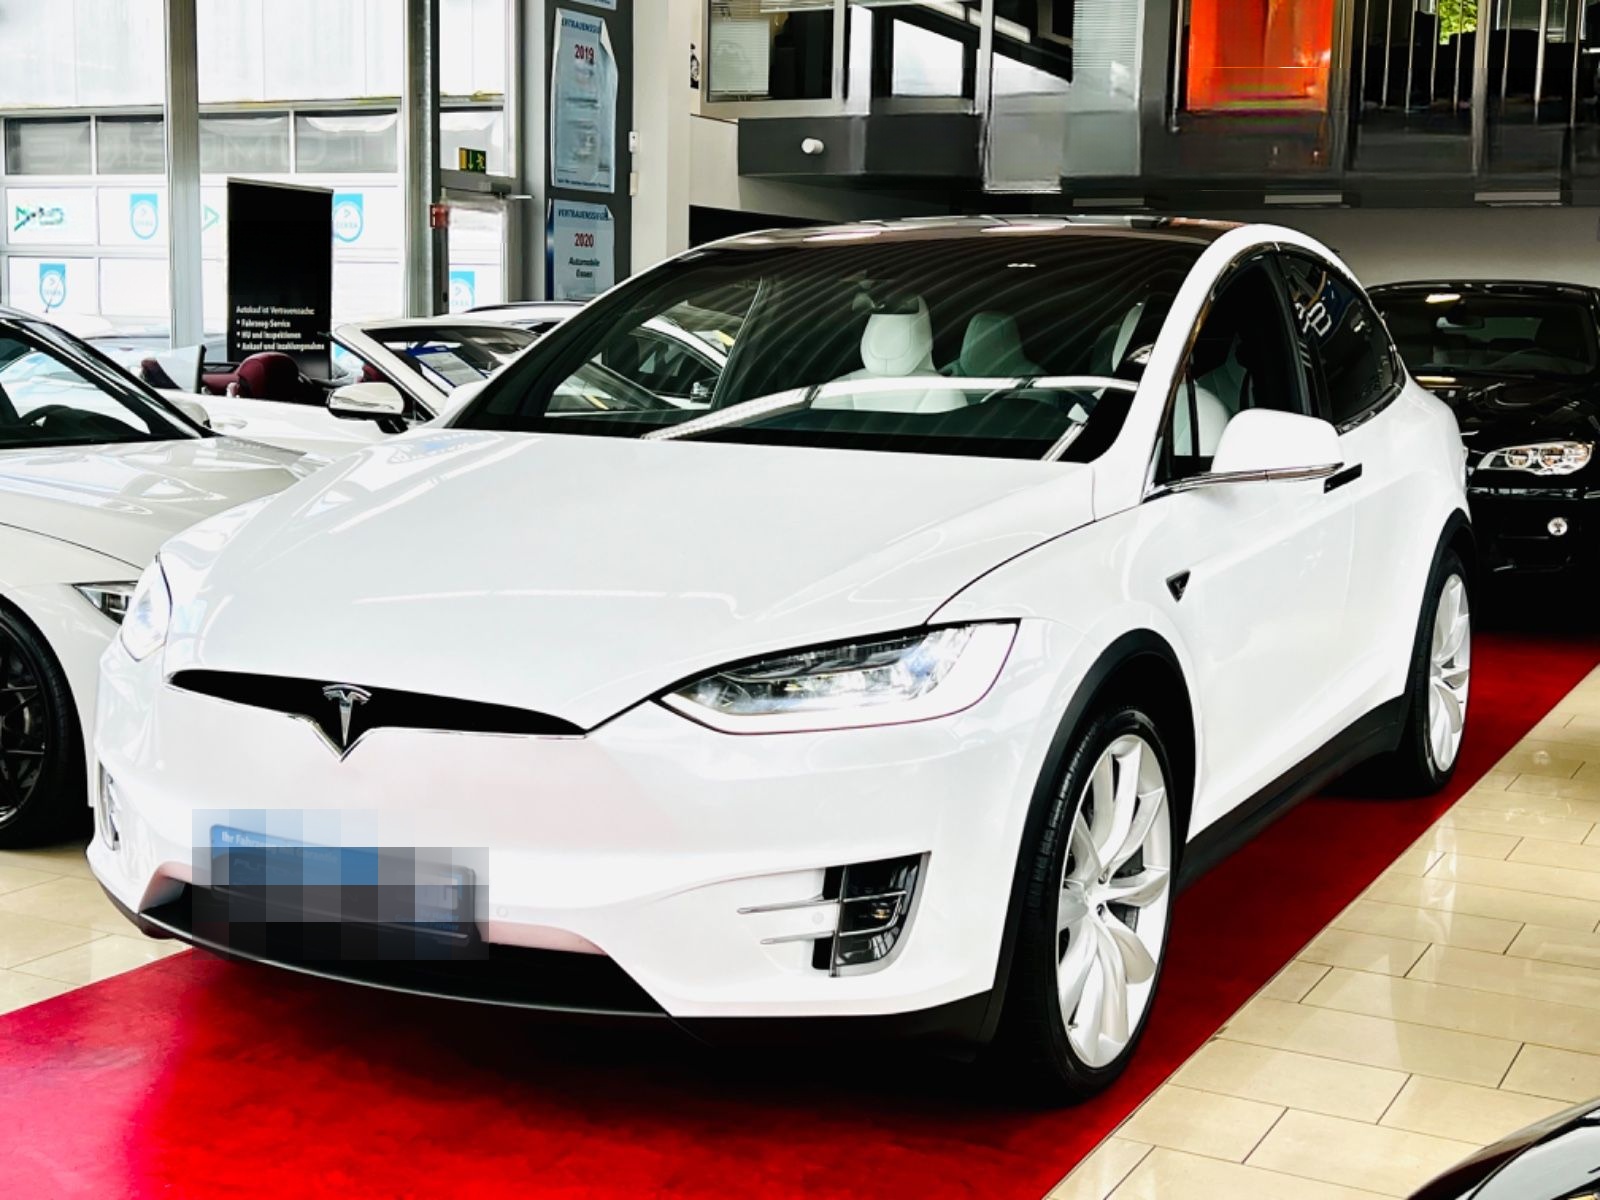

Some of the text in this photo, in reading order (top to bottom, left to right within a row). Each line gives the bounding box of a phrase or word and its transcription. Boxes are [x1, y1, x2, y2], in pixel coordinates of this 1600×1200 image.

[574, 43, 595, 63] 2019
[574, 232, 595, 248] 2020
[236, 305, 261, 314] Autokauf
[261, 305, 269, 314] ist
[241, 318, 292, 329] Fahrzeug-Service
[252, 331, 263, 339] und
[241, 342, 263, 351] Ankauf
[263, 342, 276, 351] und
